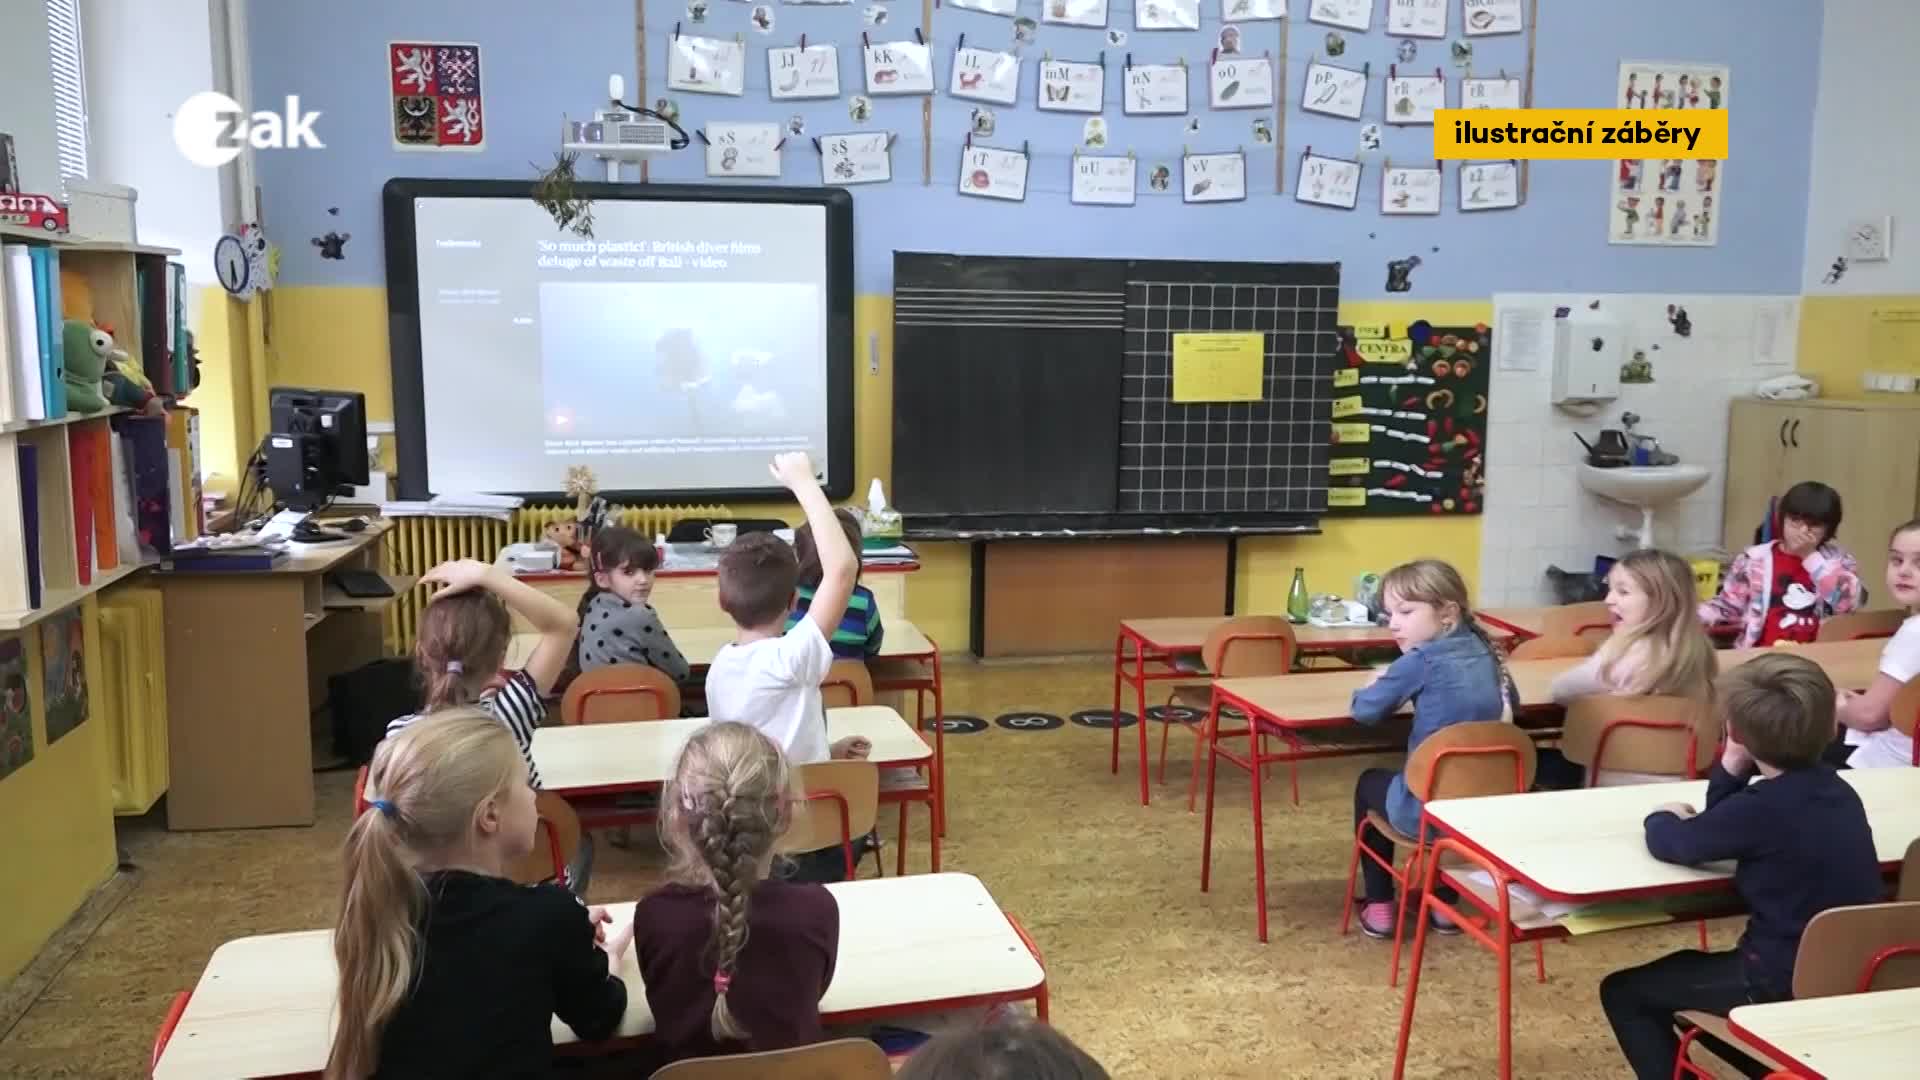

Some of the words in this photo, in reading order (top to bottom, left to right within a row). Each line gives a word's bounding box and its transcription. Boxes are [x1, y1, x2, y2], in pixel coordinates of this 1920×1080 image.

[874, 49, 893, 63] kK
[559, 240, 596, 252] much
[537, 255, 581, 271] deluge
[583, 255, 598, 267] of
[600, 257, 636, 268] waste
[638, 255, 656, 268] off
[692, 255, 728, 269] video
[1360, 343, 1408, 353] CENTRA
